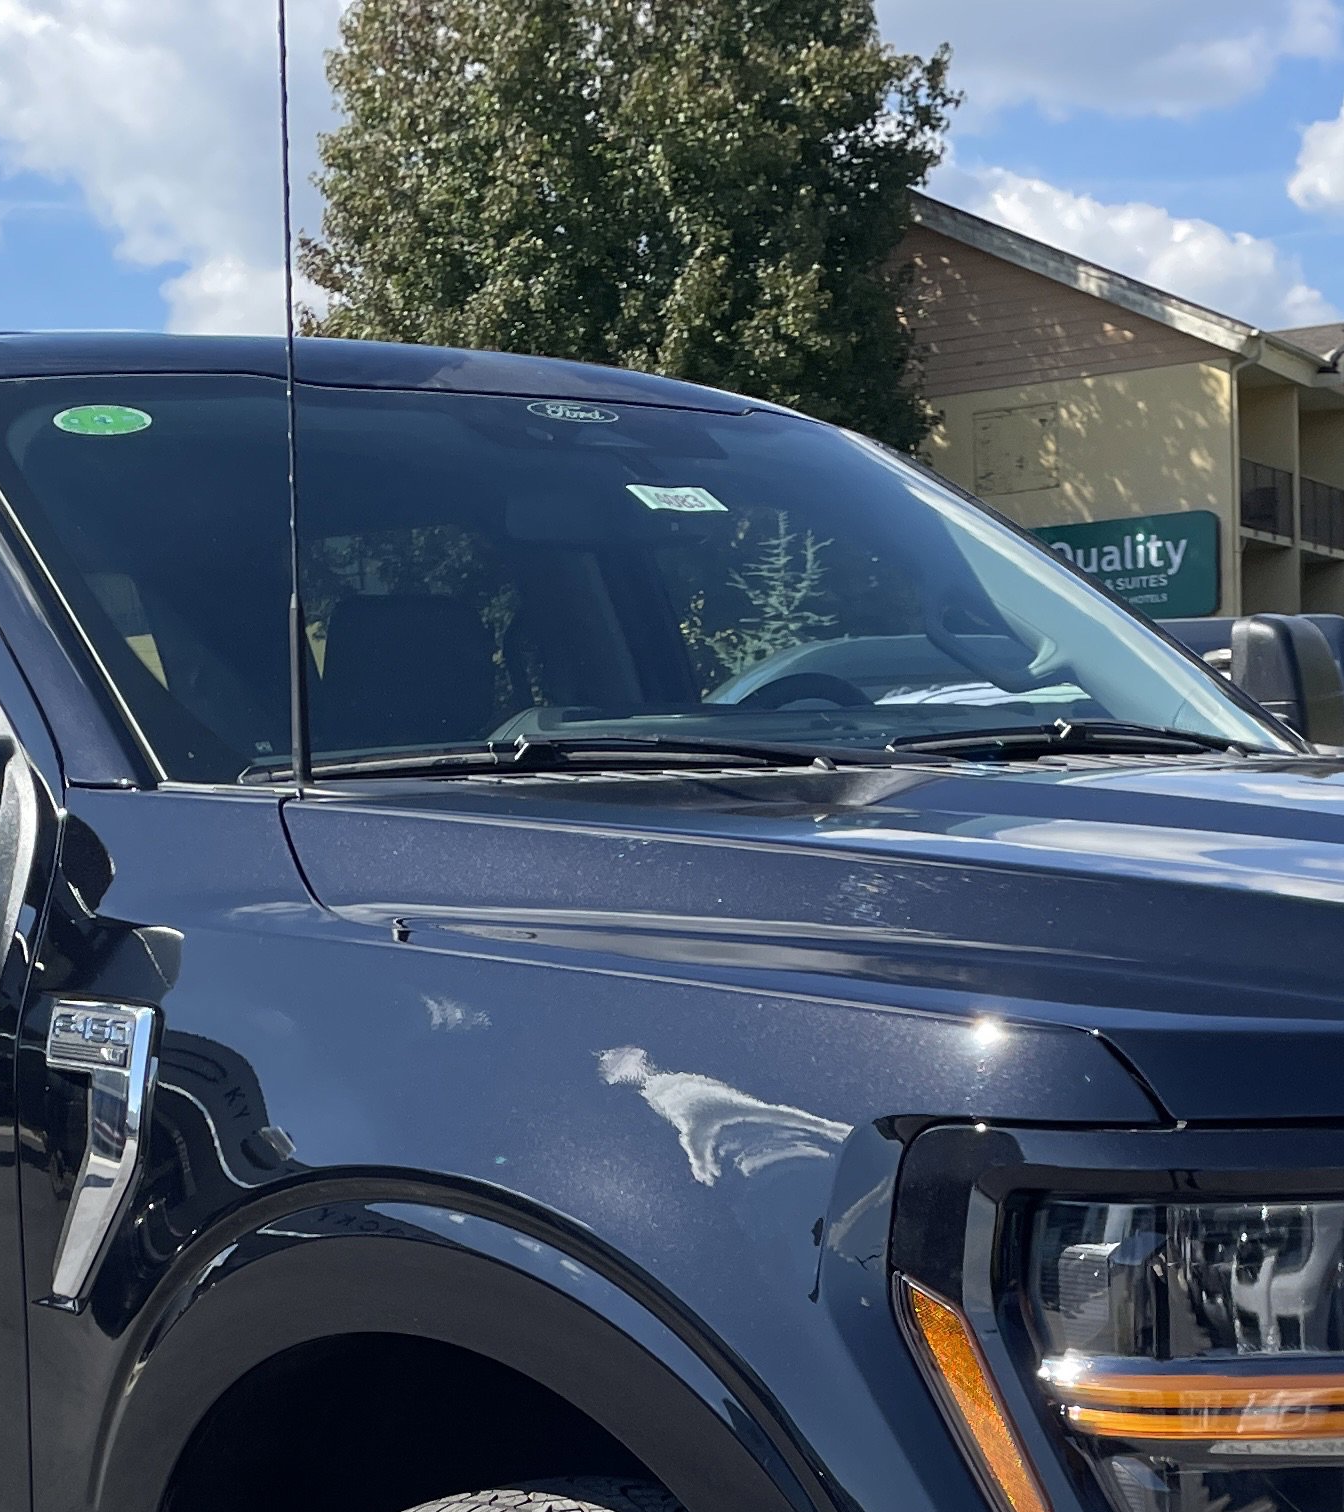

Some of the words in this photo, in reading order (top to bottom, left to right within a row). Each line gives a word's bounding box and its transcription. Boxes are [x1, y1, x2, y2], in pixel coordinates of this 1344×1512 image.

[545, 402, 606, 421] Ford
[1050, 532, 1188, 576] Quality
[1115, 574, 1168, 591] SUITES
[53, 1013, 132, 1046] F-150
